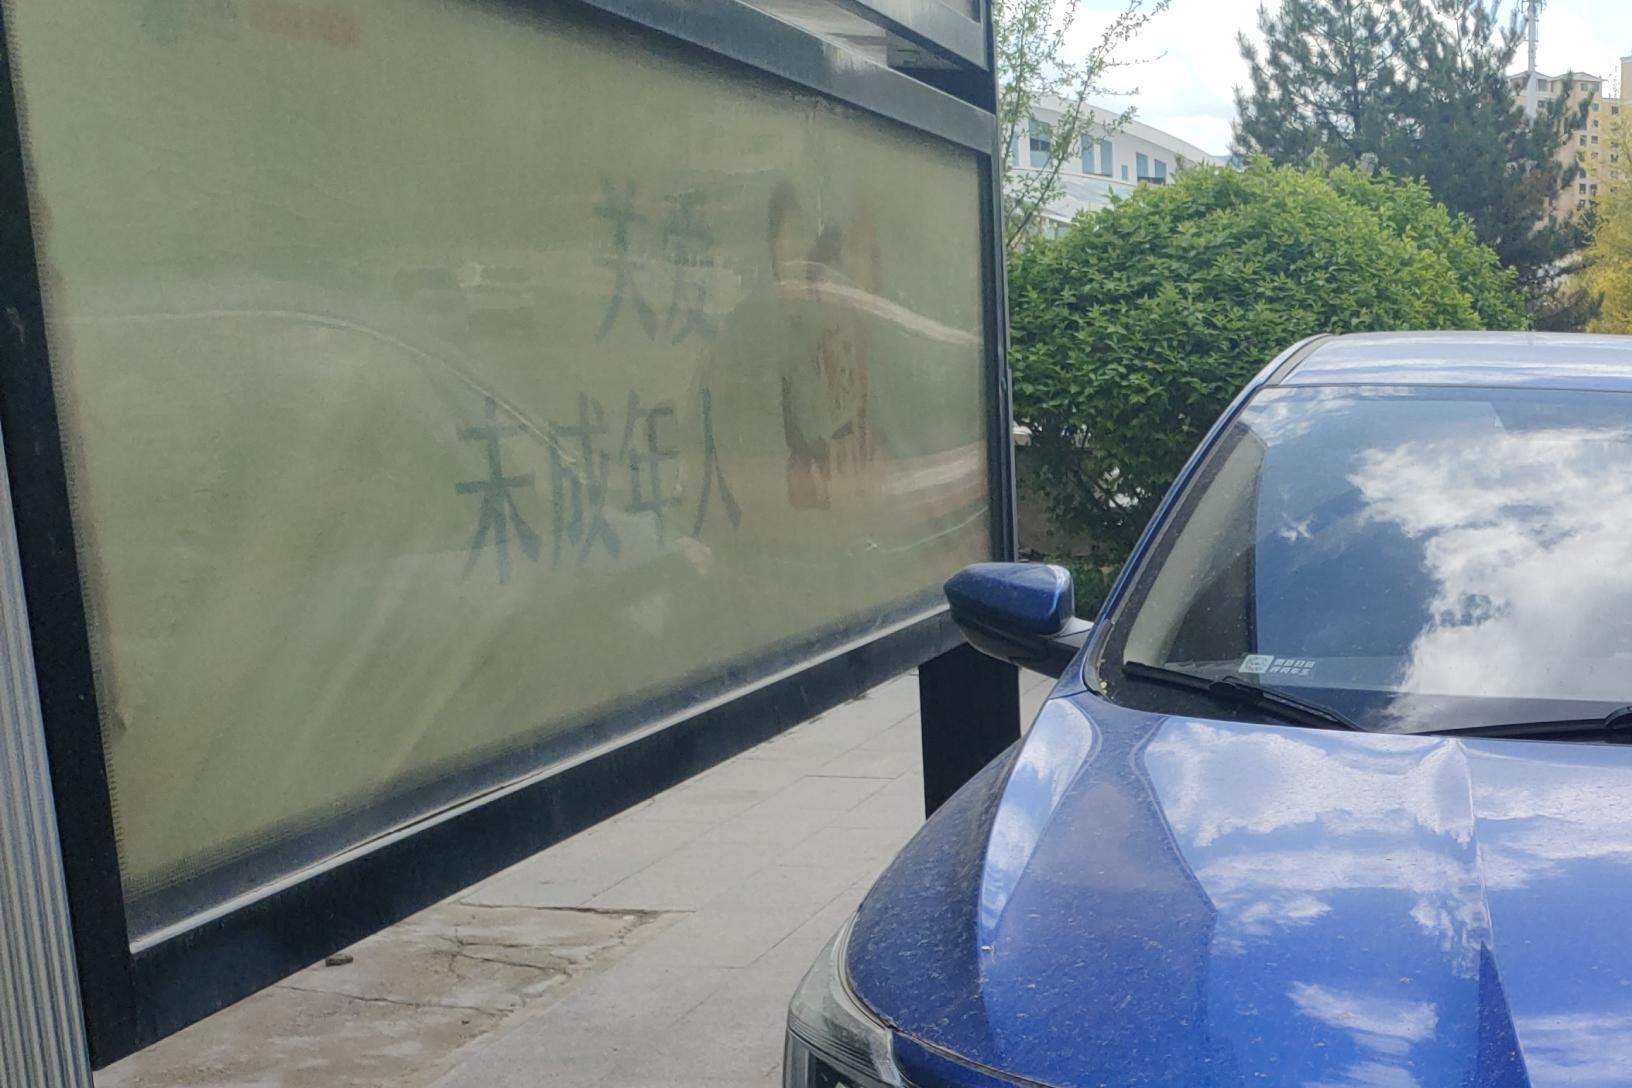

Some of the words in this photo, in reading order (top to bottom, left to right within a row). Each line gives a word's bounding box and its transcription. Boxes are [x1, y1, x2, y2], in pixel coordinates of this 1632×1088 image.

[594, 178, 720, 346] 关爱
[456, 386, 743, 586] 未成年人
